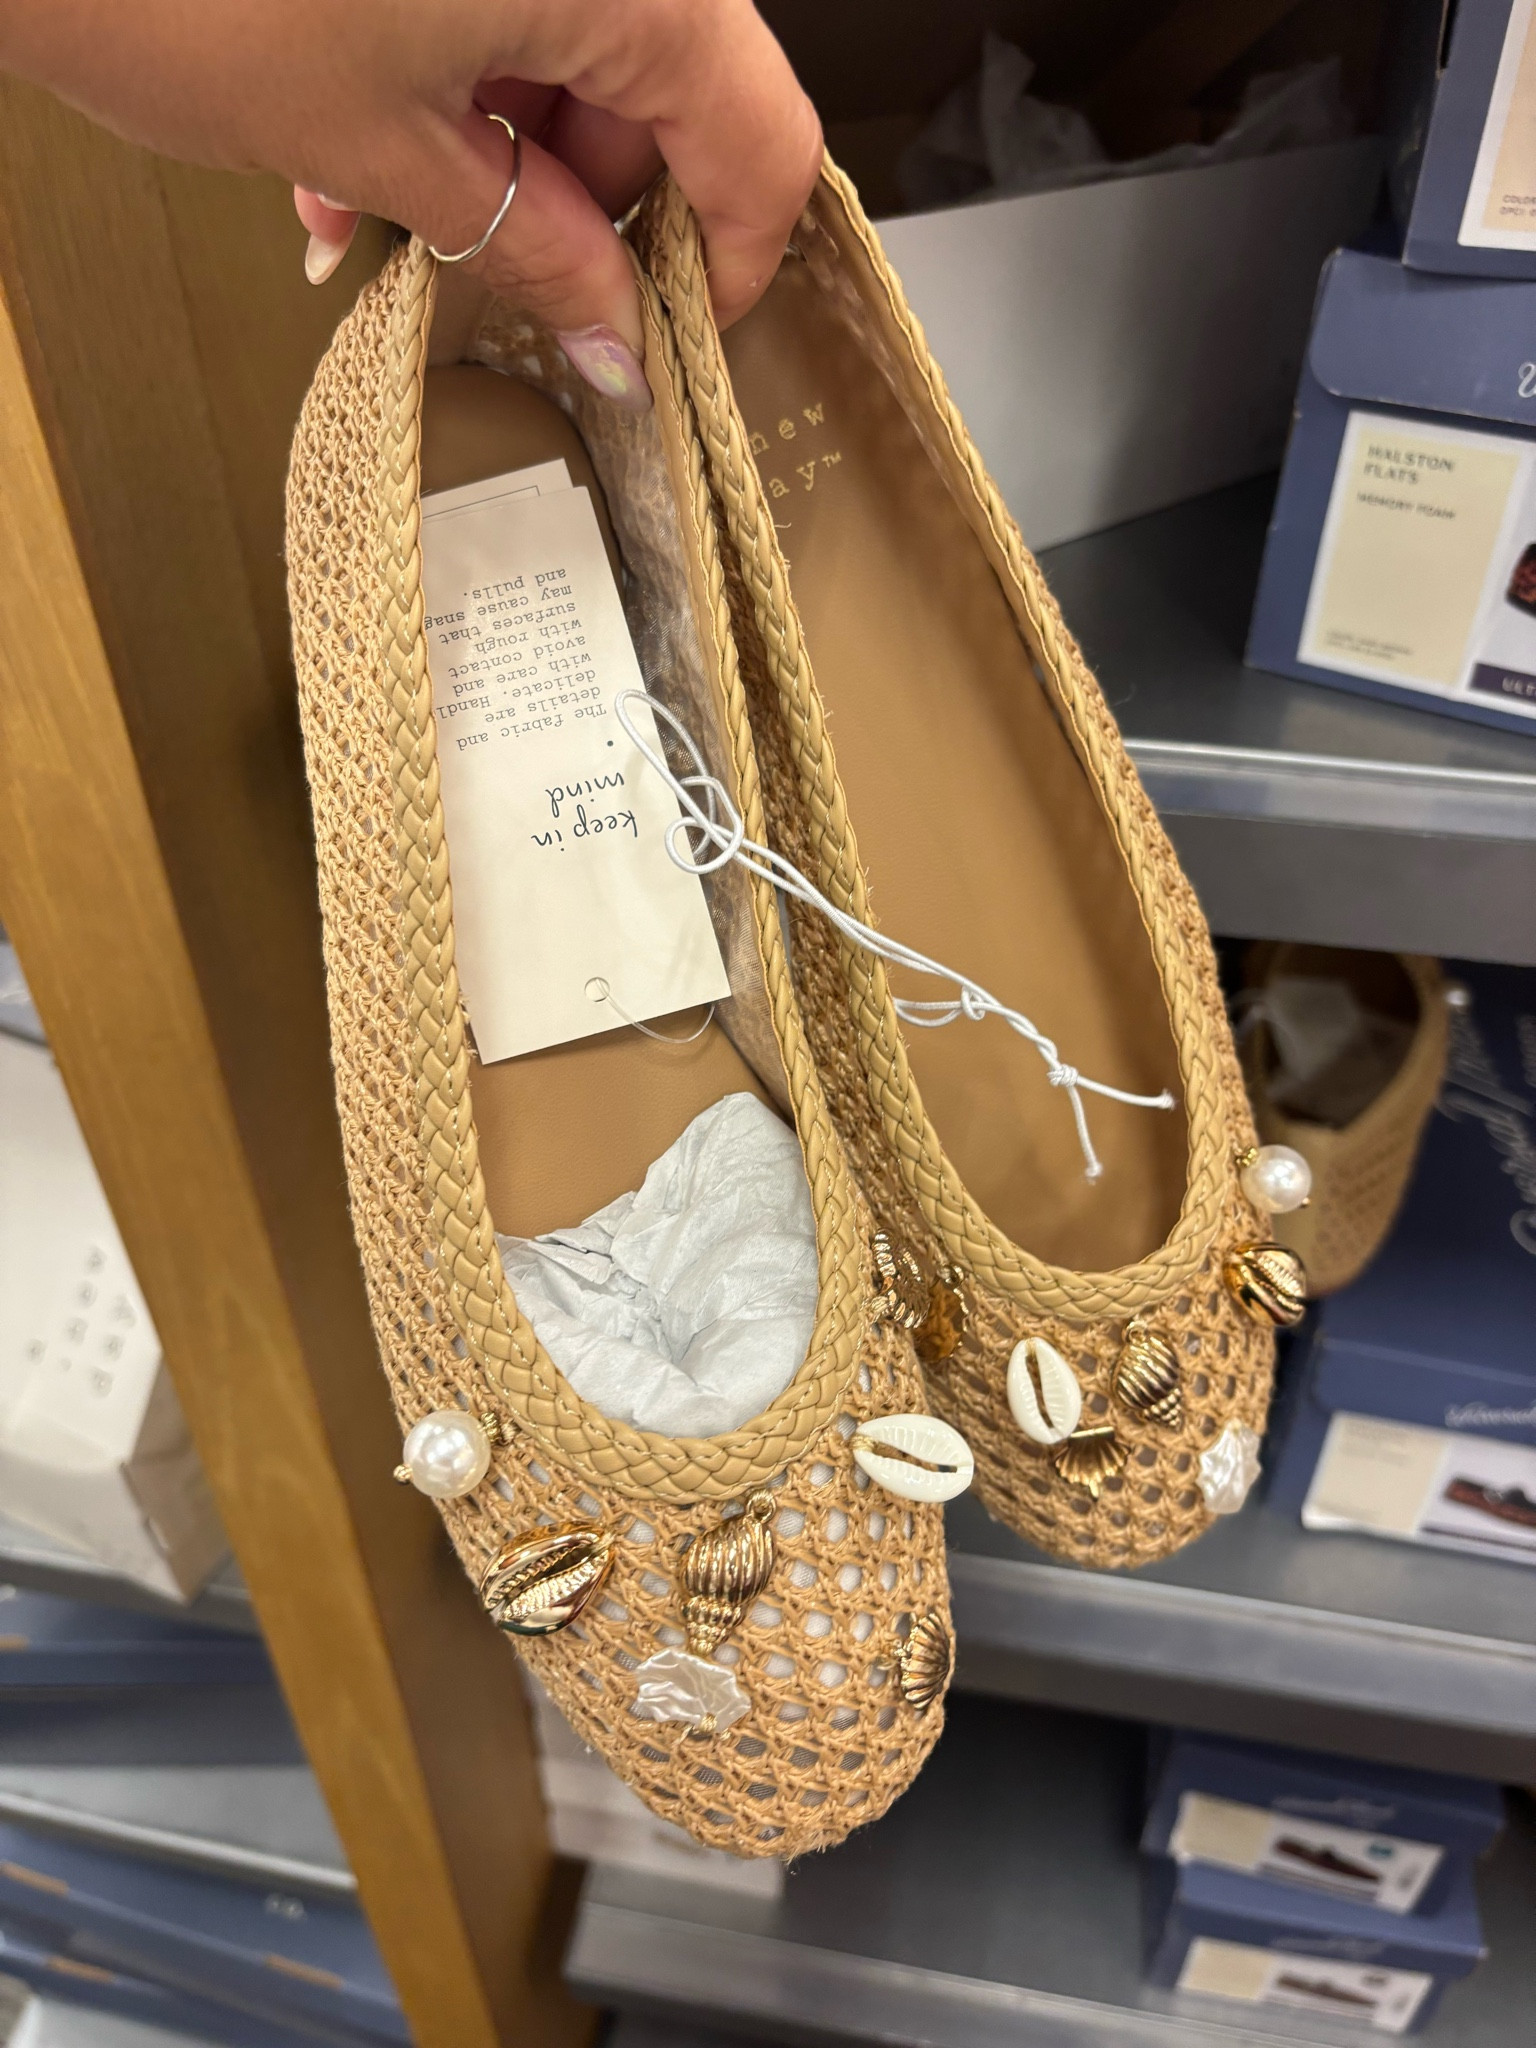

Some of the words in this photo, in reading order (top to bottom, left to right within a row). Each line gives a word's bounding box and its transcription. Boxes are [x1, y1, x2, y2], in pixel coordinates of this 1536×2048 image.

[750, 403, 825, 456] new
[463, 575, 525, 600] pulls.
[534, 568, 567, 587] and
[541, 585, 572, 601] may
[477, 596, 529, 616] cause
[492, 602, 576, 631] surfaces
[439, 626, 482, 645] that
[539, 618, 582, 637] with
[474, 631, 529, 654] rough
[533, 635, 586, 660] avoid
[448, 652, 522, 679] contact
[548, 652, 592, 672] with
[496, 666, 538, 684] care
[503, 669, 596, 698] delicate.
[452, 679, 485, 698] and
[528, 686, 601, 713] details
[436, 695, 491, 720] Handl
[485, 707, 516, 723] are
[574, 703, 607, 719] The
[501, 714, 564, 738] fabric
[456, 732, 489, 751] and
[545, 772, 625, 818] mind
[573, 804, 638, 838] keep
[531, 829, 565, 852] in
